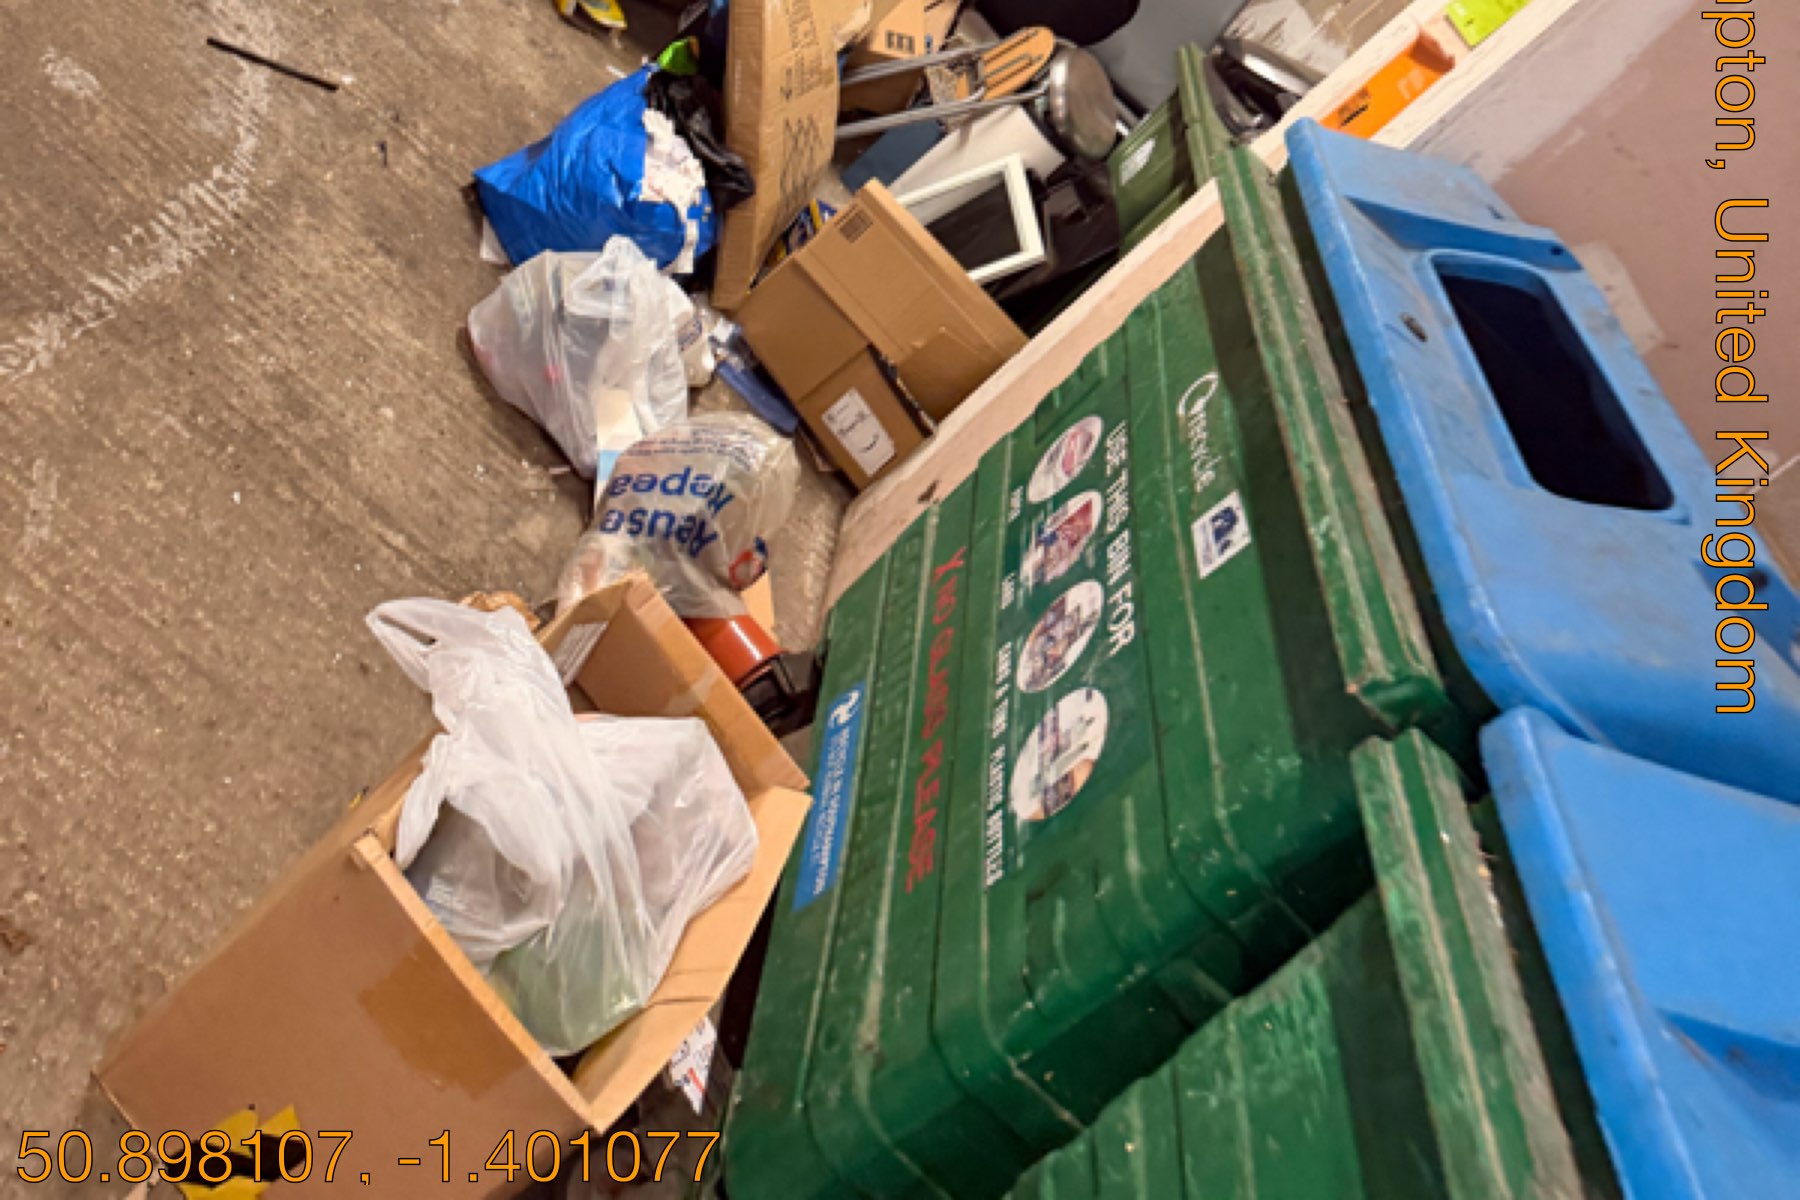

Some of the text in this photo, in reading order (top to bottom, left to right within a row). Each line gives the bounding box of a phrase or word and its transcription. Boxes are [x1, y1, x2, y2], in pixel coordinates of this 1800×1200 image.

[599, 507, 718, 559] Reuse
[1105, 419, 1136, 657] USE THIS BIN FOR
[932, 574, 959, 625] NO
[921, 626, 955, 740] GLASS
[903, 737, 944, 895] PLEASE
